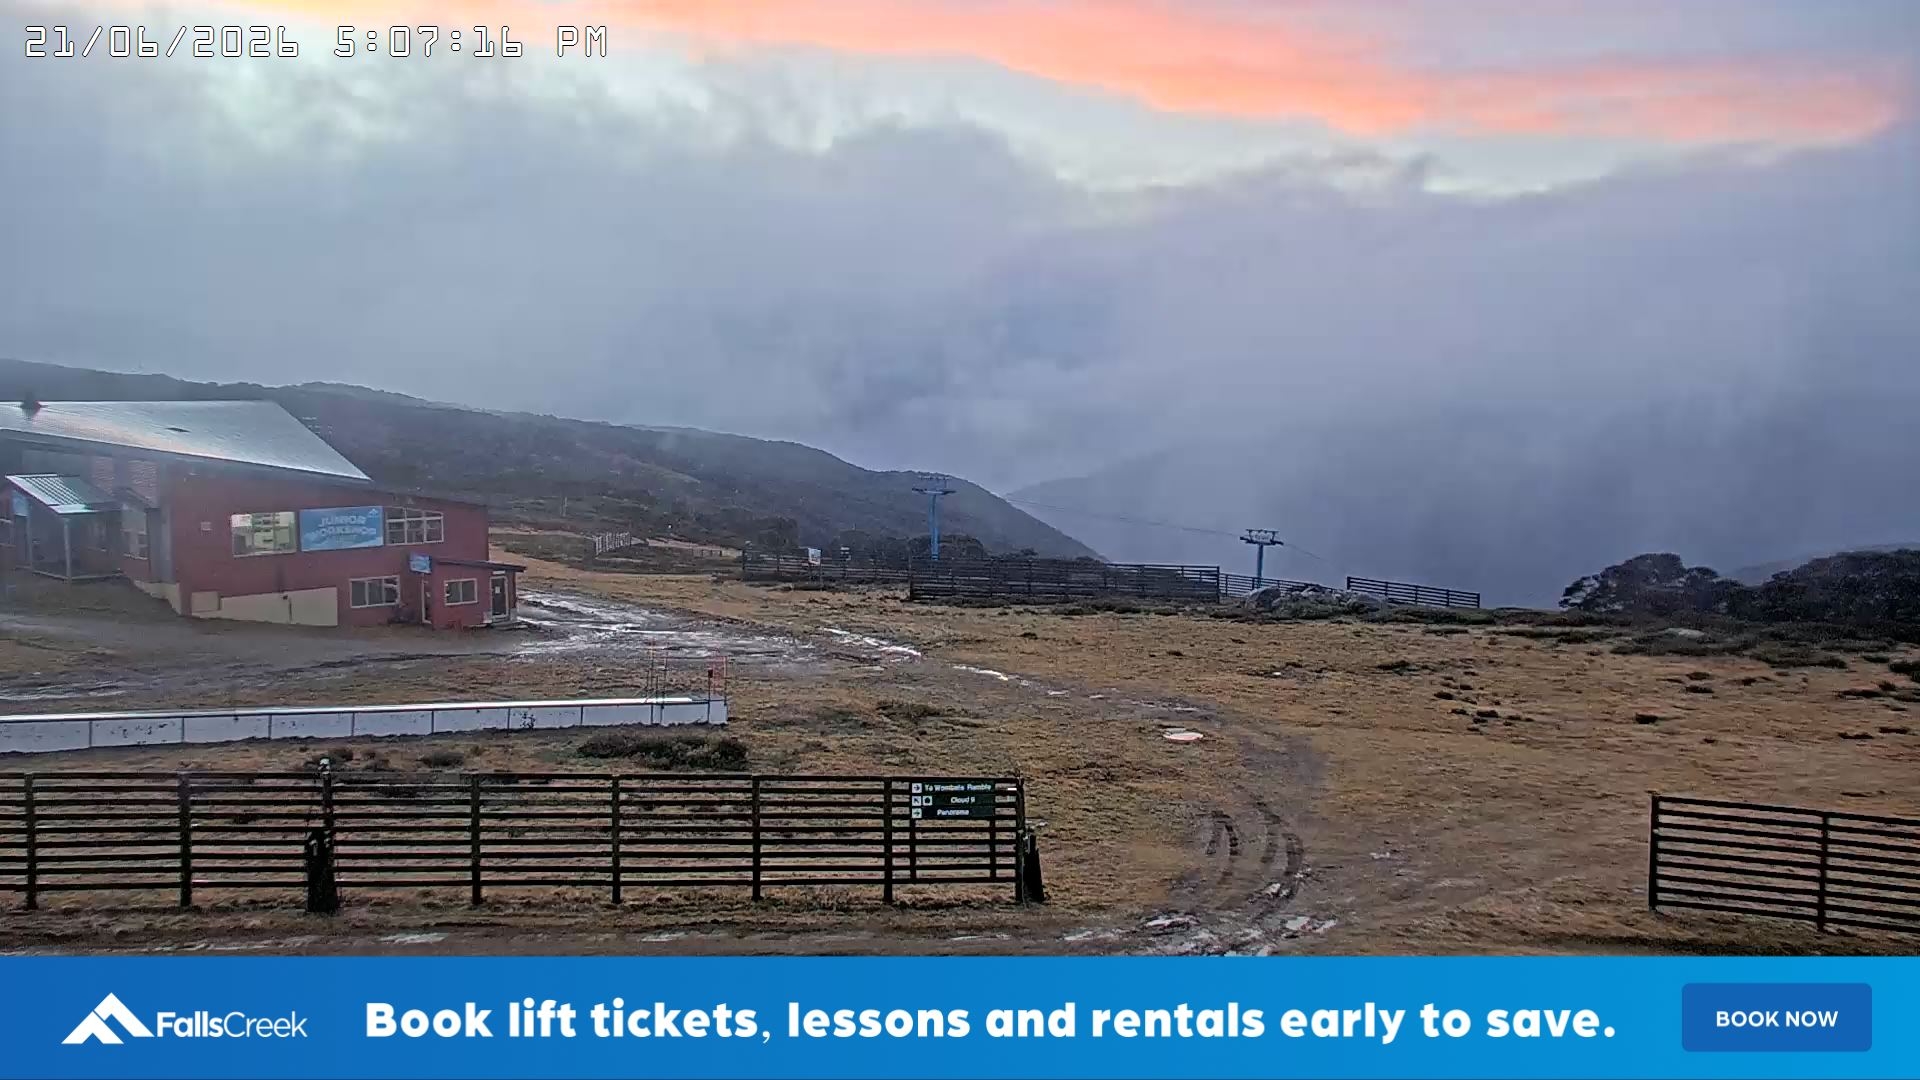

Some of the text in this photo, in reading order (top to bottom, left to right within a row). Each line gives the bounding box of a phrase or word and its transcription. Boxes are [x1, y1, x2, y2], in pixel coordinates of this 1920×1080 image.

[318, 515, 367, 527] JUNIOR
[924, 783, 934, 792] To
[950, 796, 976, 804] Cloud 9
